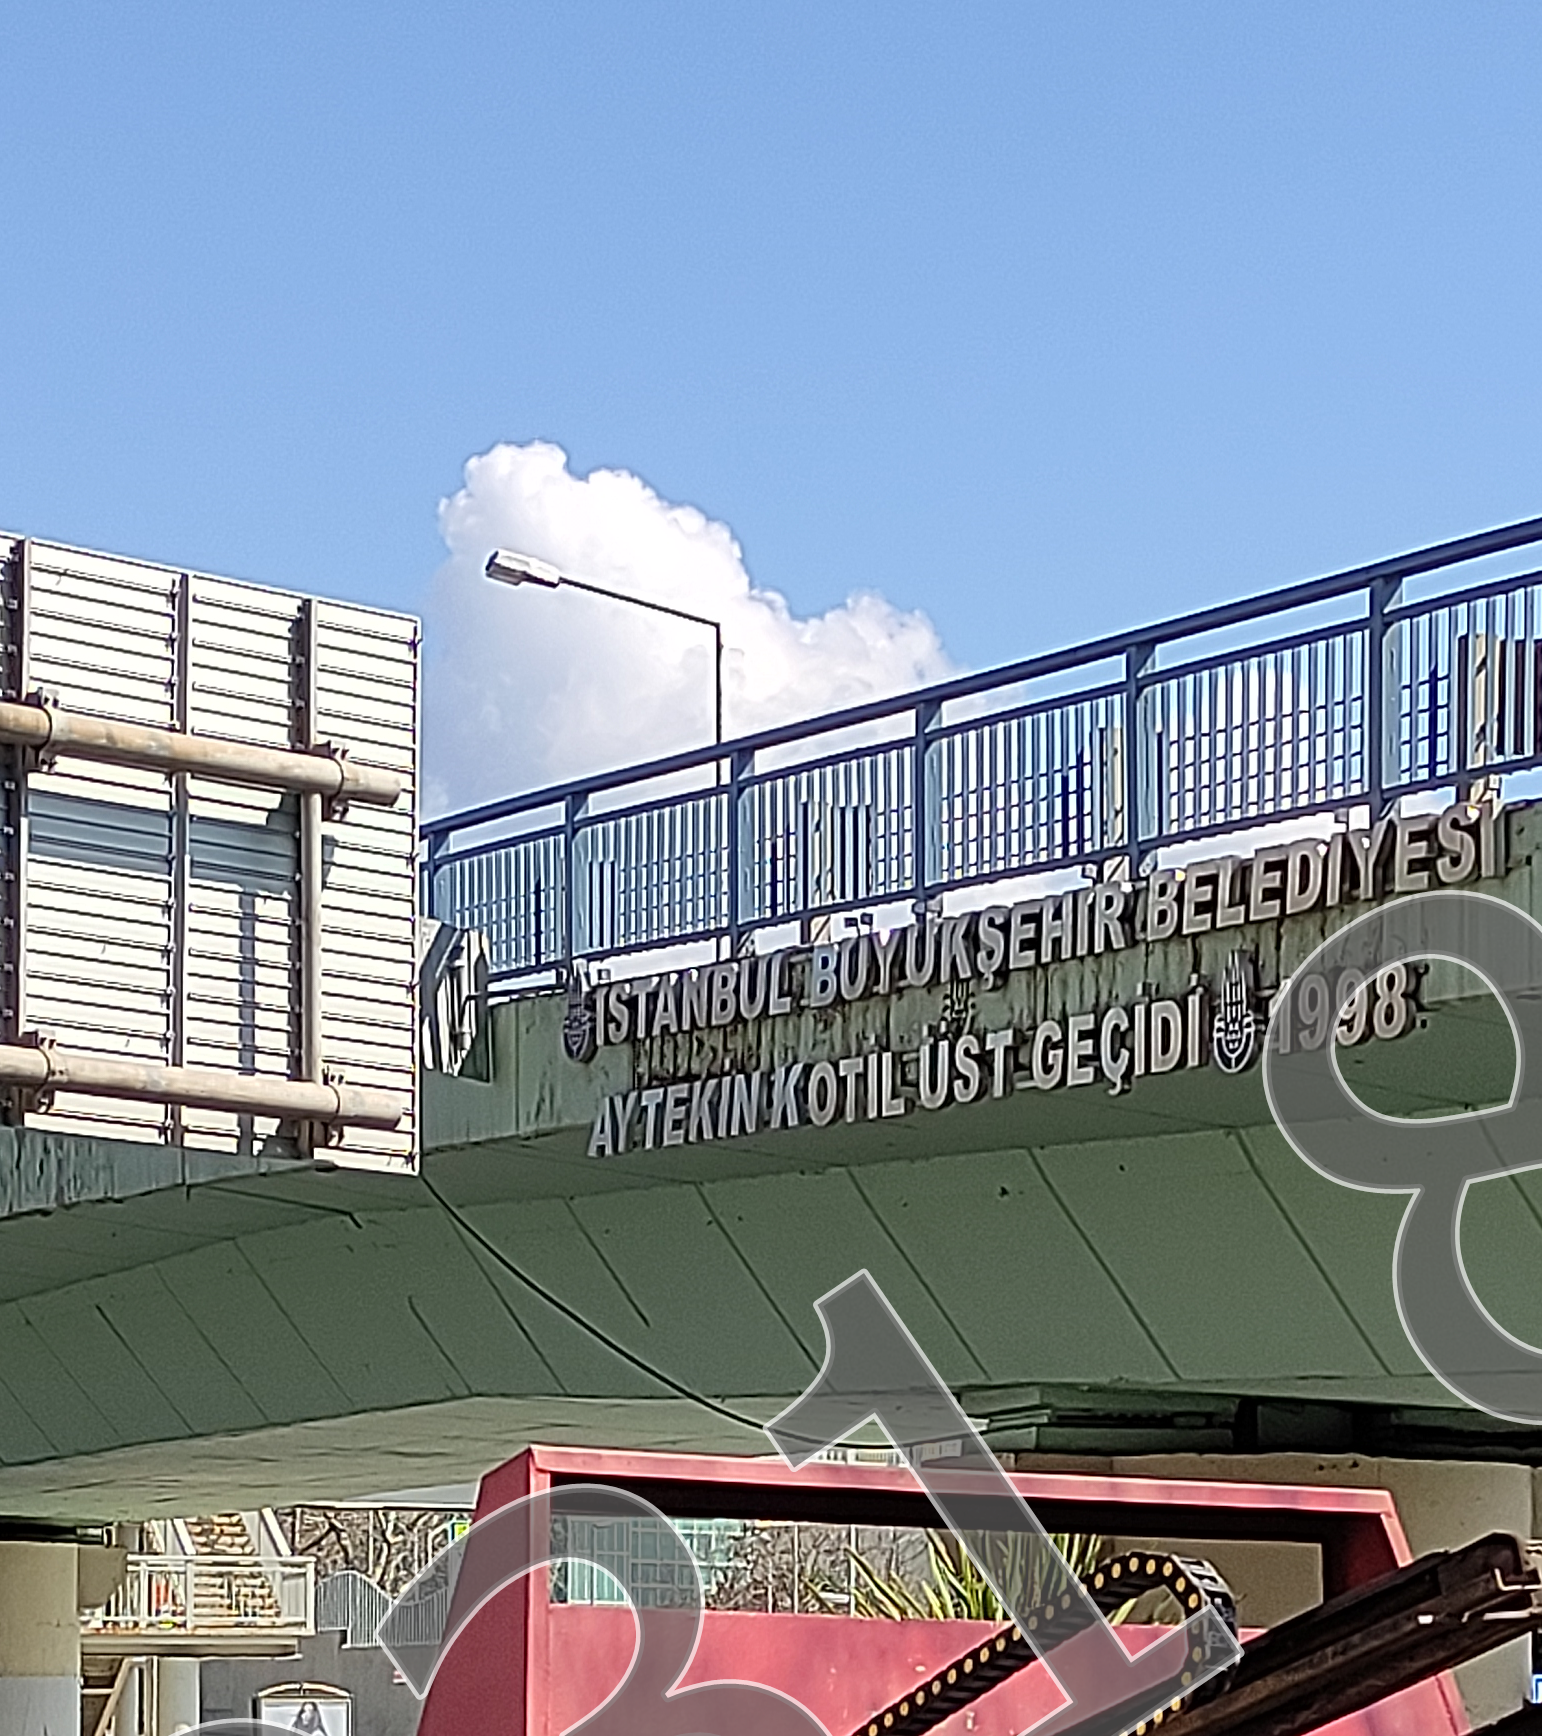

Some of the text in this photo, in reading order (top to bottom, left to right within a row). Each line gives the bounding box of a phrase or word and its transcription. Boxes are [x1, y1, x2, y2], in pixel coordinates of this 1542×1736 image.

[768, 1036, 905, 1130] KOTİL
[919, 1022, 1012, 1110] ÜST
[1032, 976, 1201, 1096] GEÇİDİ
[1268, 962, 1408, 1055] 1998
